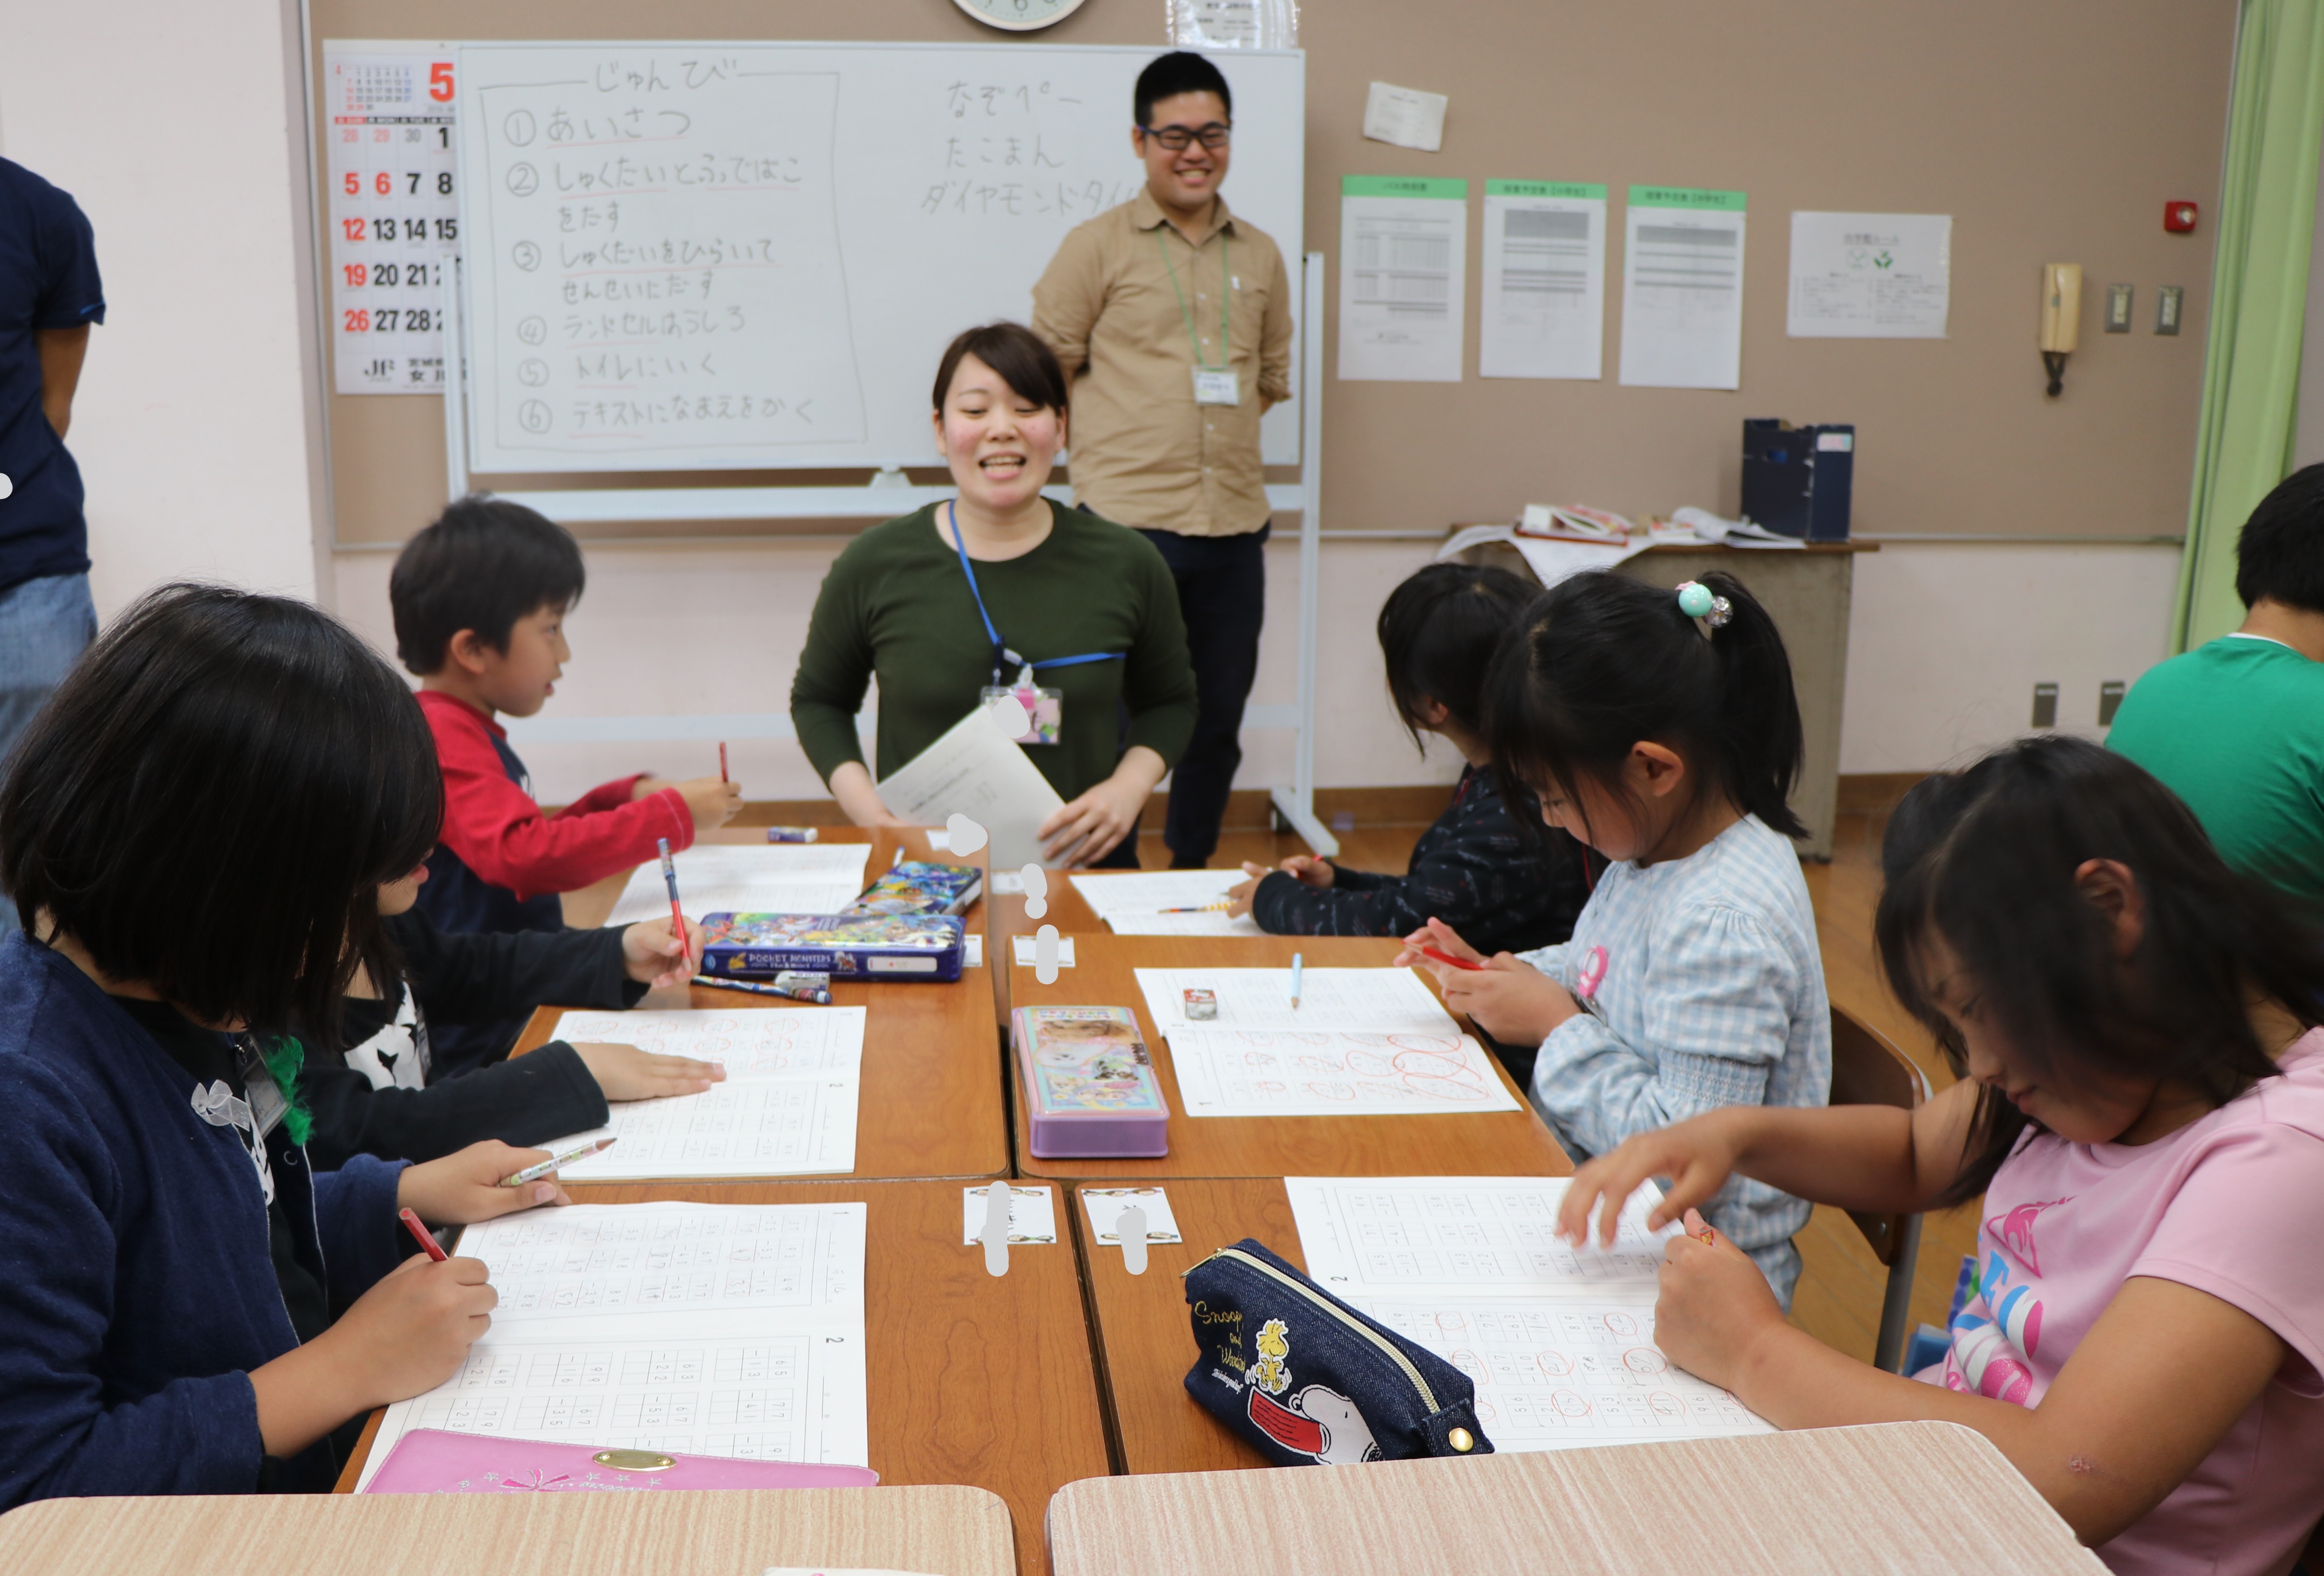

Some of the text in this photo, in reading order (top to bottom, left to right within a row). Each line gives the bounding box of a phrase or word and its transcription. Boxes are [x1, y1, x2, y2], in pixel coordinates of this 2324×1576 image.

[430, 62, 455, 102] 5
[595, 58, 738, 93] じゅんび
[946, 80, 1082, 118] なぞペー
[547, 106, 691, 142] あいさつ
[343, 127, 449, 149] 28 29 30 1
[946, 134, 1066, 168] たこまん
[345, 173, 453, 195] 5 6 7 8
[343, 219, 457, 241] 12 13 14 15
[344, 264, 427, 286] 19 20 21
[344, 310, 430, 332] 26 27 28
[575, 352, 717, 381] トイレにいく
[749, 954, 831, 963] POCKET MONSTERS
